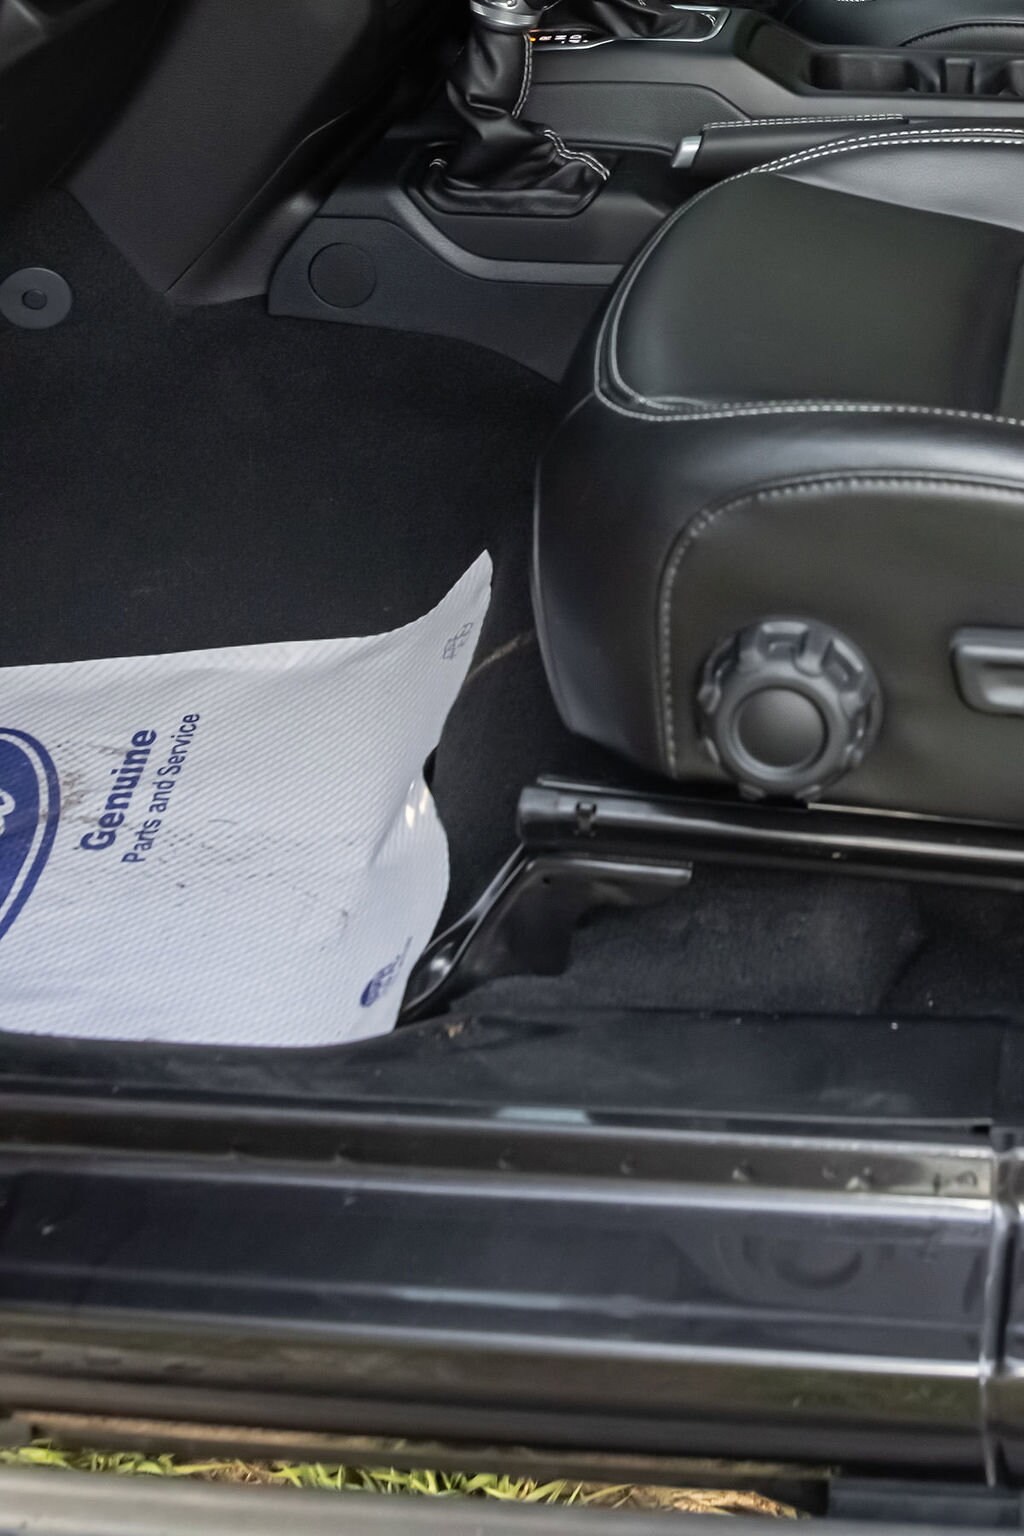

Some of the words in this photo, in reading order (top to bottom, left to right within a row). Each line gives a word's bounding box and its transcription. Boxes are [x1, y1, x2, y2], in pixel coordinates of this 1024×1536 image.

[158, 713, 201, 776] Service
[81, 729, 157, 851] Genuine
[149, 779, 175, 813] and
[121, 819, 162, 863] Parts
